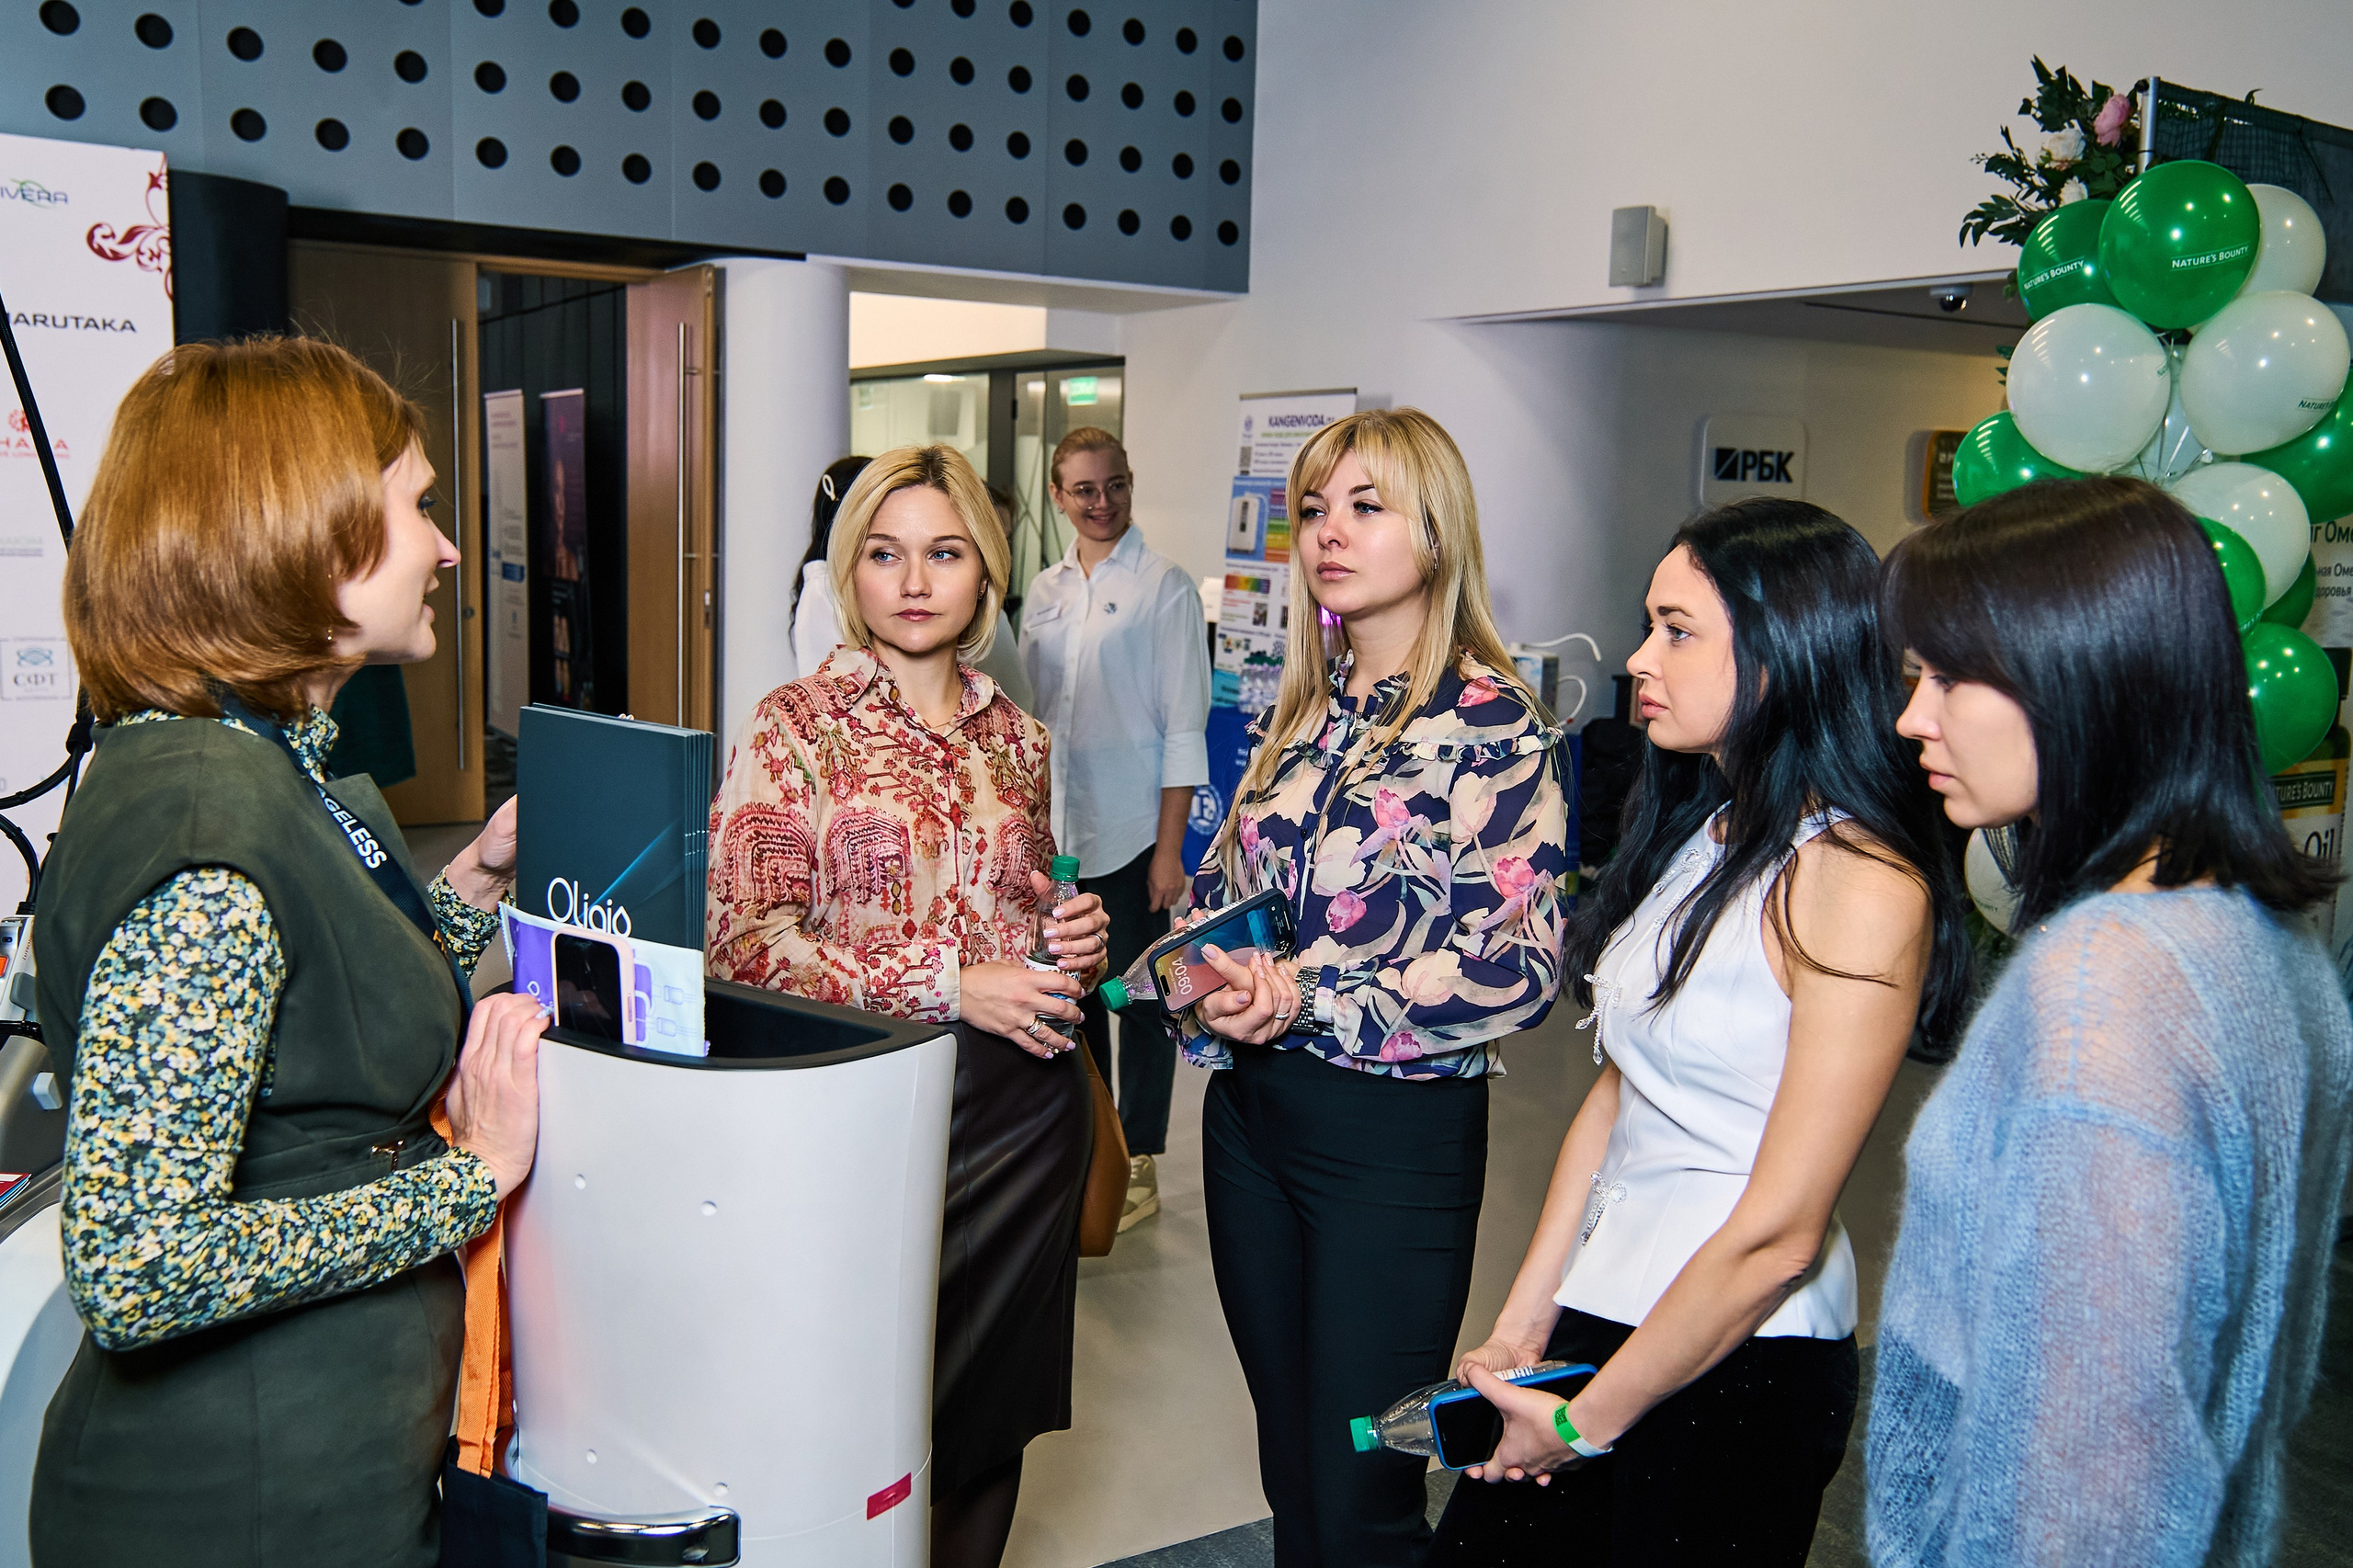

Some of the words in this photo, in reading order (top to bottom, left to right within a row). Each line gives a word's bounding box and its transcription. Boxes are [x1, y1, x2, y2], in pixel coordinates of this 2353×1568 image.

[2172, 253, 2217, 268] NATURE'S
[2219, 245, 2249, 261] BOUNTY
[2023, 272, 2050, 290] NATURE'S
[2050, 259, 2085, 278] BOUNTY
[6, 312, 137, 333] ARUTAKA
[1741, 449, 1795, 483] РБК
[2275, 784, 2302, 801] TURE'S
[1172, 957, 1193, 995] 09:04
